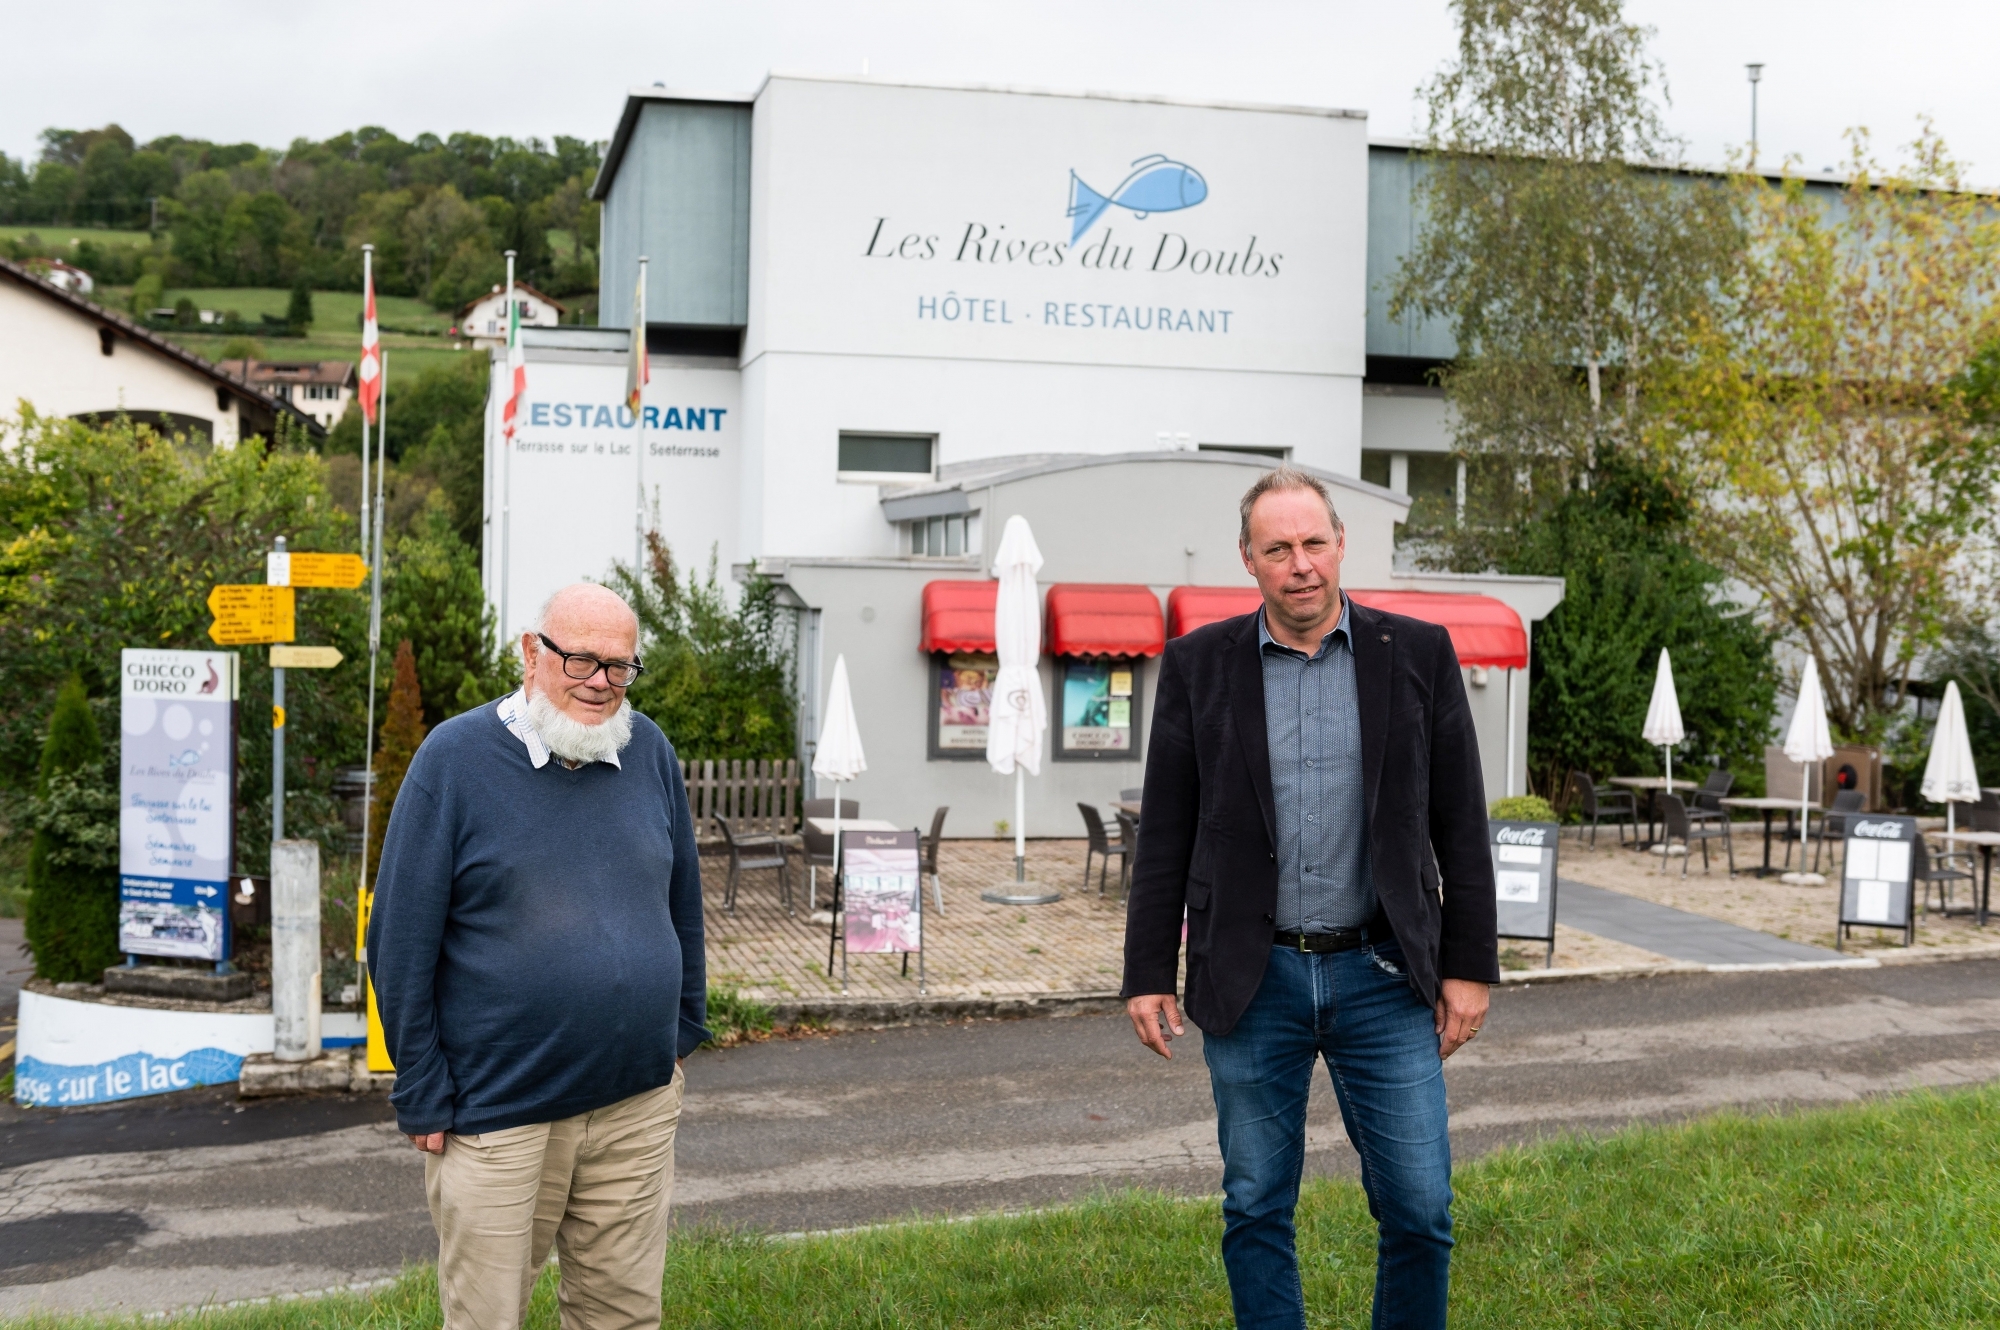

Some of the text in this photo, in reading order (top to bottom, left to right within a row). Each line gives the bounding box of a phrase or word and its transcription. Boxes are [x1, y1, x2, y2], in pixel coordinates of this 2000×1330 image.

[860, 216, 1284, 279] Les Rives du Doubs
[917, 291, 1234, 334] HÔTEL RESTAURANT
[523, 402, 728, 432] ESTAURANT
[515, 438, 720, 458] Terrasse sur le Lac Seeterrasse
[127, 662, 195, 679] CHICCO
[1496, 826, 1547, 846] Coca-Cola
[1853, 819, 1904, 839] Coca-Cola
[105, 1065, 132, 1097] le
[140, 1057, 188, 1092] lac
